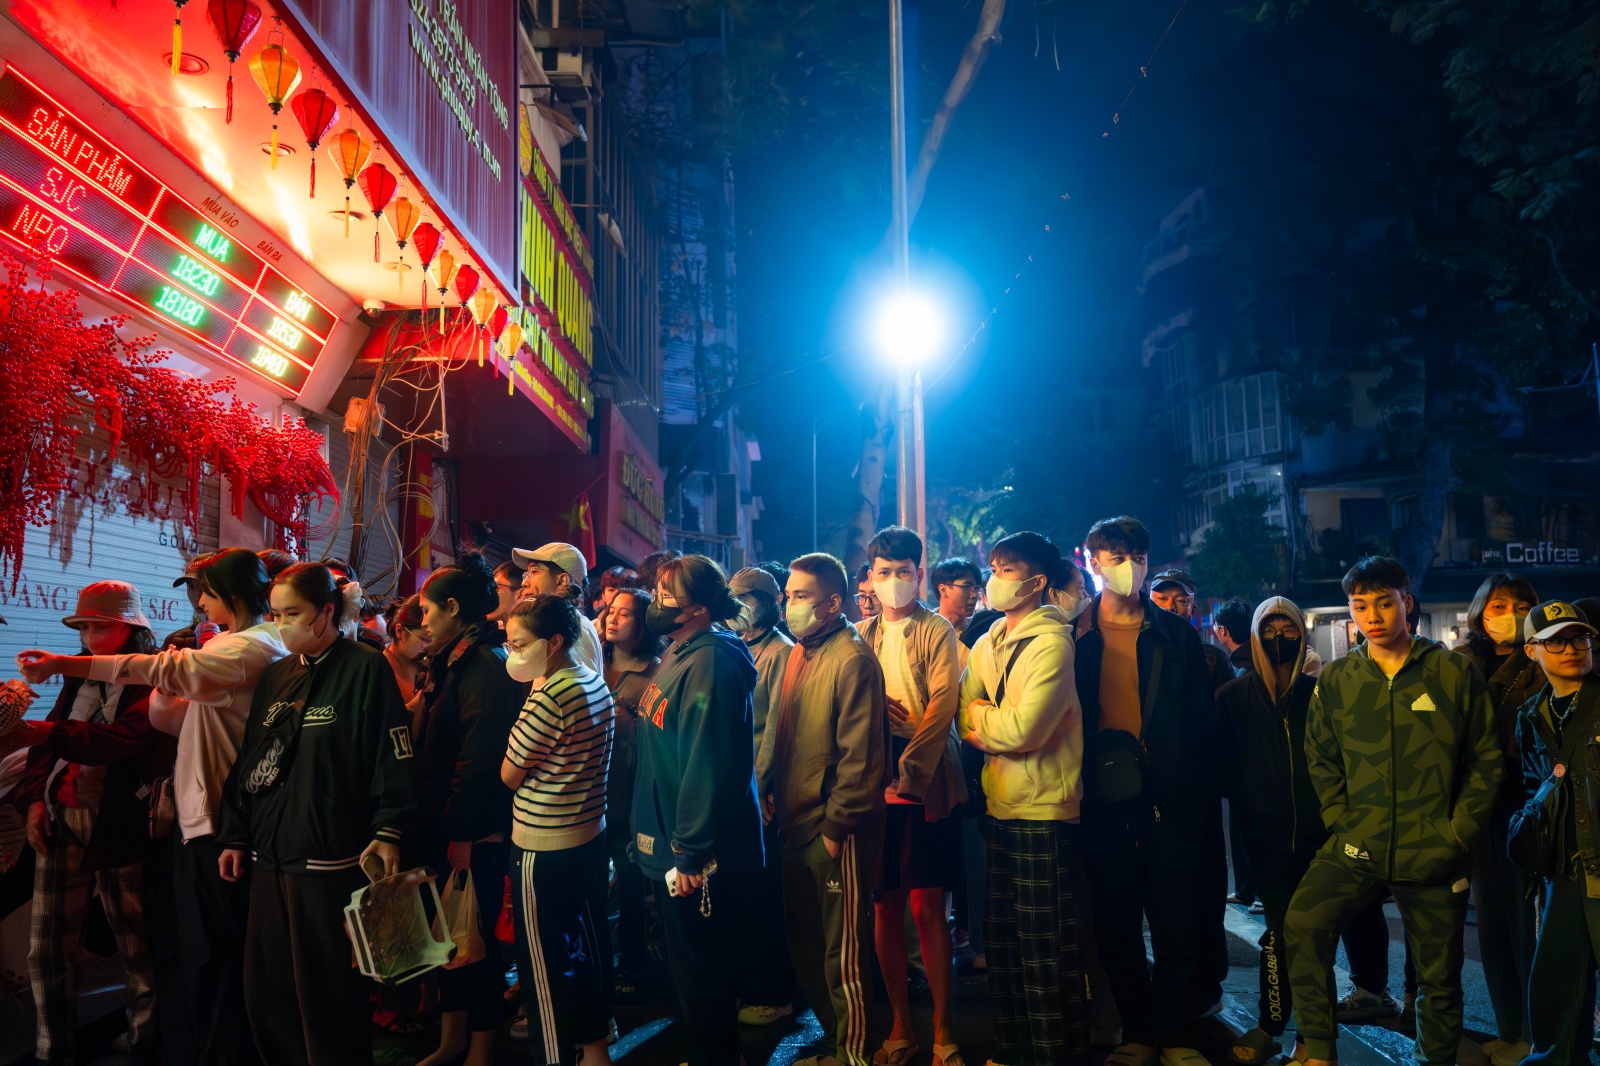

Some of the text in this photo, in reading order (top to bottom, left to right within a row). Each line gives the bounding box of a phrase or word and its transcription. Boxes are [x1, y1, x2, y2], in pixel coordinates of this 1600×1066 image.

[431, 17, 454, 73] 3573
[455, 57, 476, 108] 5959
[464, 36, 488, 96] NHÂN
[488, 79, 509, 130] TÔNG
[39, 166, 87, 212] SJC
[13, 204, 69, 254] NPQ
[220, 212, 239, 228] VÀO
[195, 223, 231, 262] MUA
[256, 240, 283, 262] BÁN RA
[172, 254, 221, 296] 18230
[155, 286, 205, 326] 18180
[557, 250, 594, 369] QUANG
[159, 531, 199, 553] GOLD
[1505, 541, 1580, 563] Coffee
[148, 597, 179, 622] SJC
